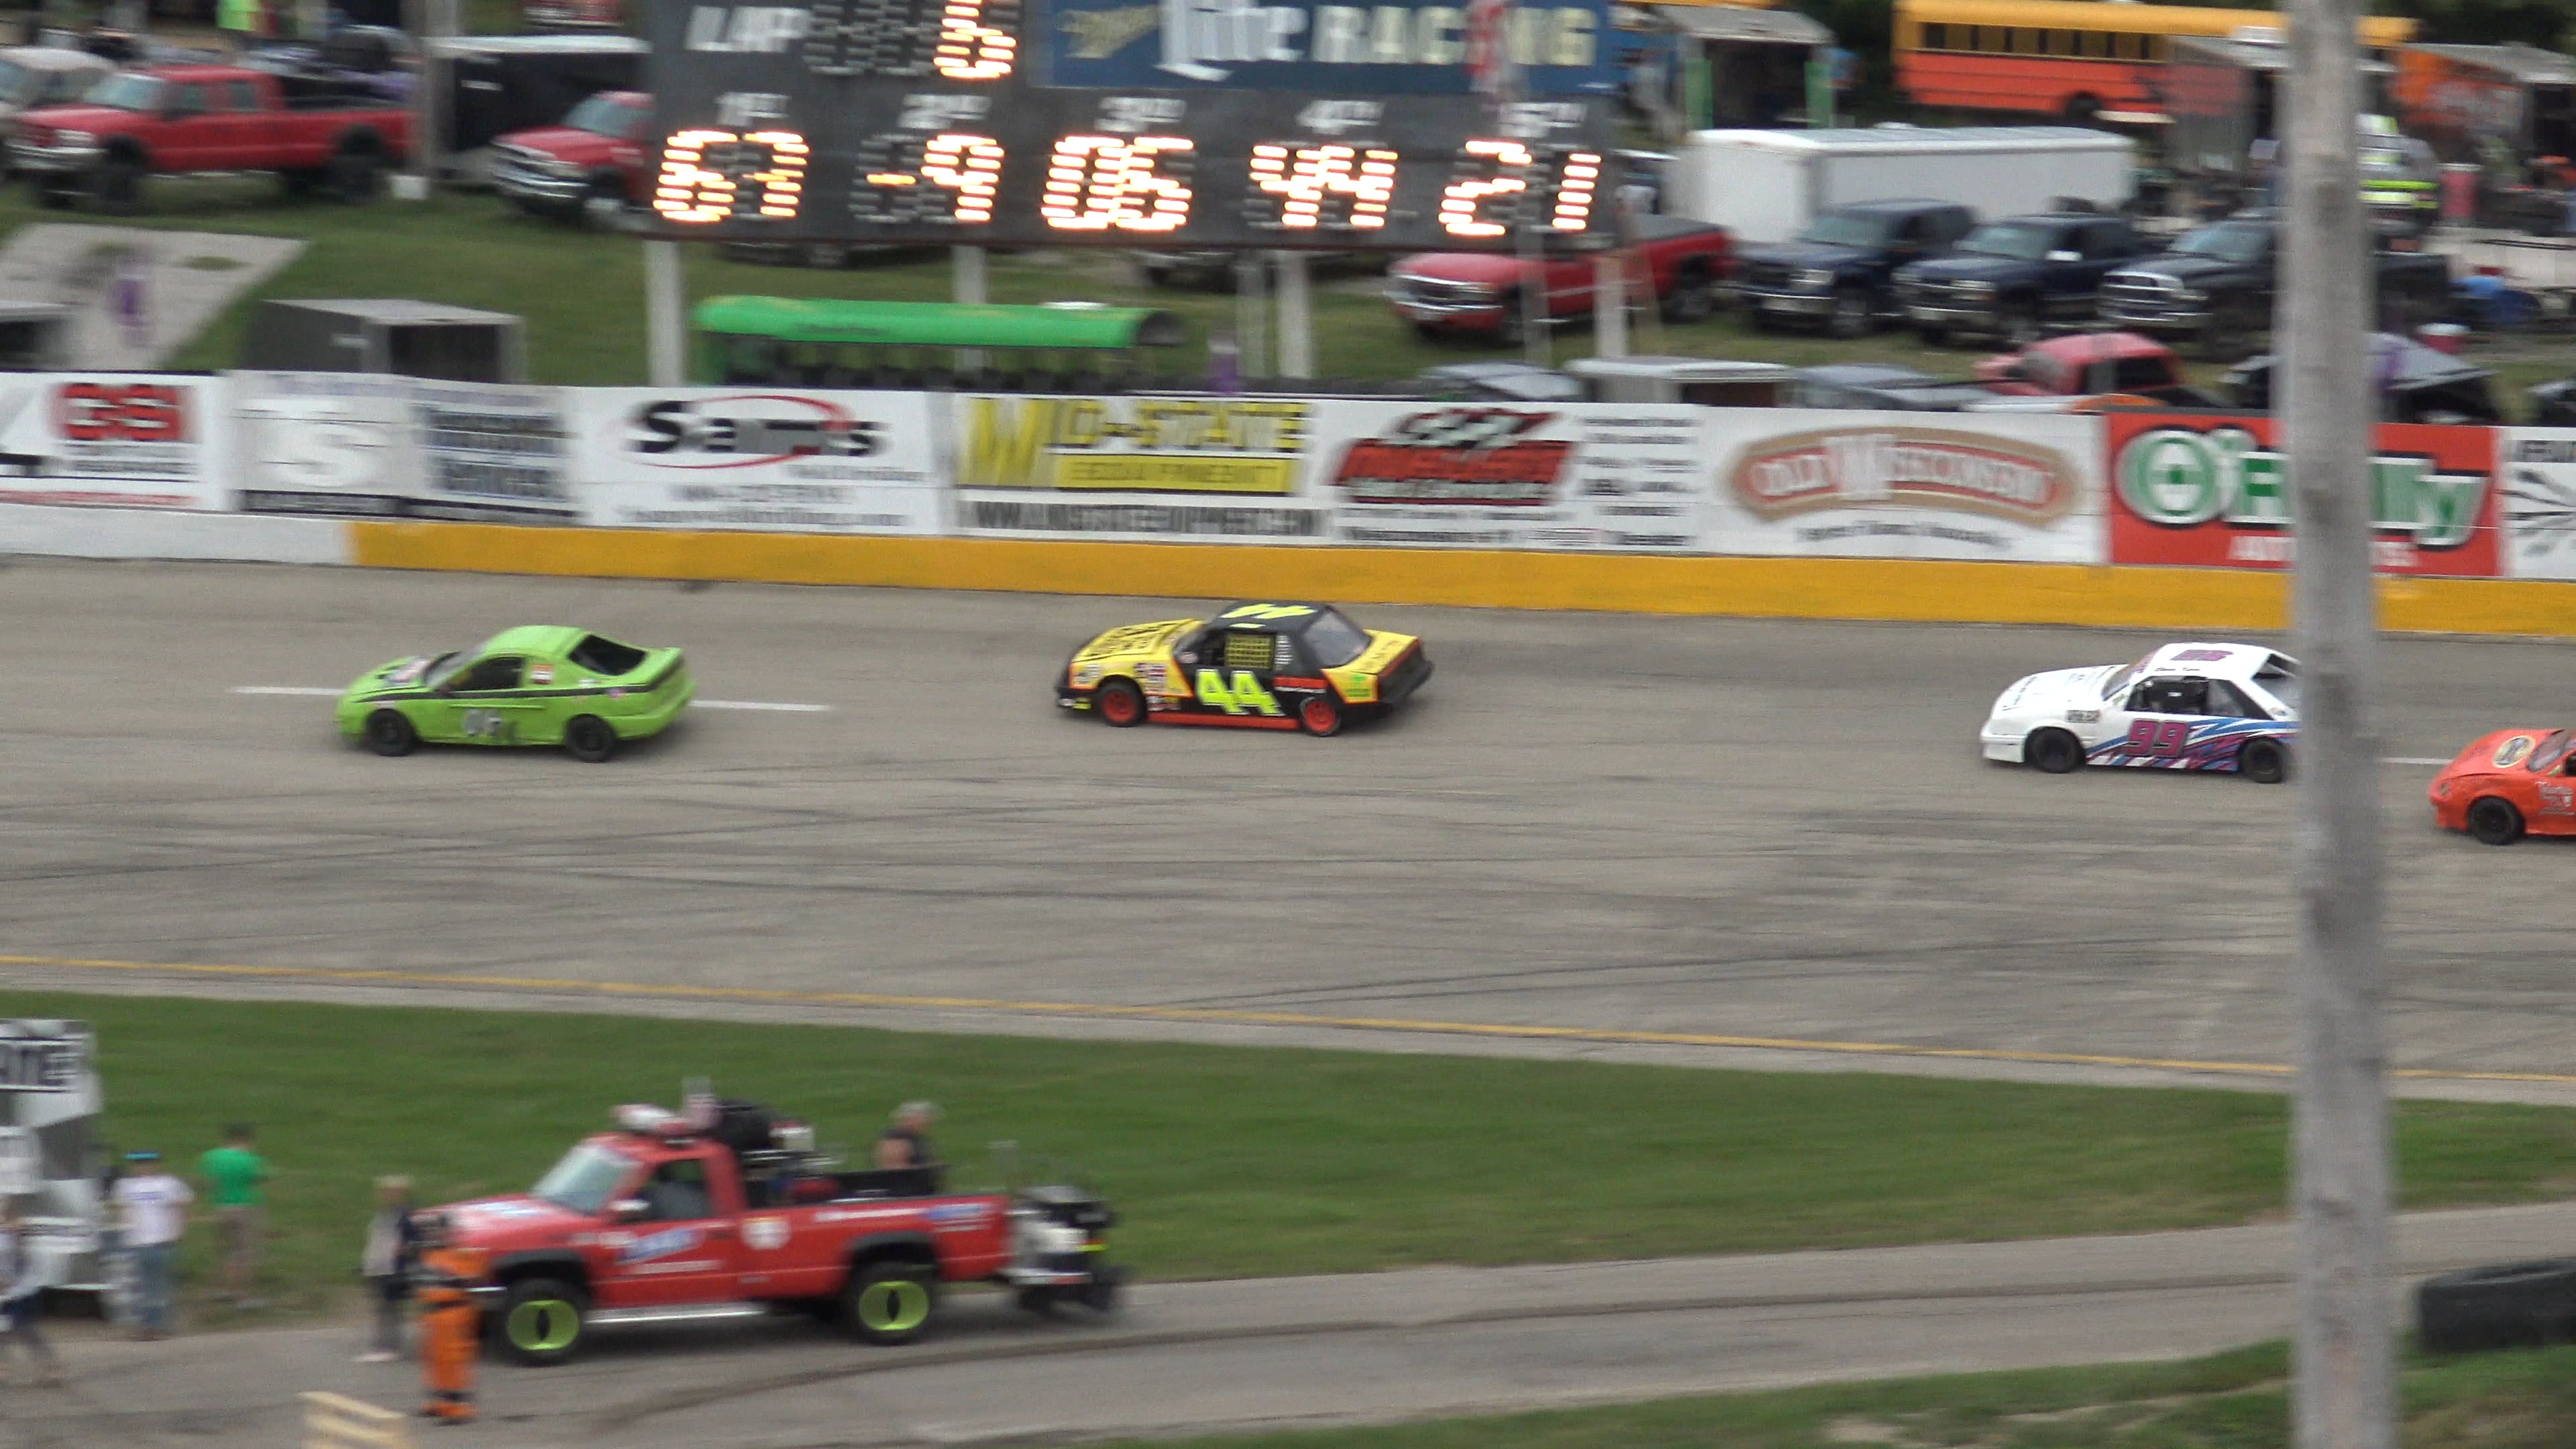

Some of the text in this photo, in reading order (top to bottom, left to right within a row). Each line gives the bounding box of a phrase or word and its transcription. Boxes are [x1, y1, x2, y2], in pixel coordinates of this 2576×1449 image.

[1249, 144, 1399, 229] 44
[1438, 140, 1601, 236] 21
[1196, 668, 1286, 717] 44
[2124, 718, 2190, 757] 99
